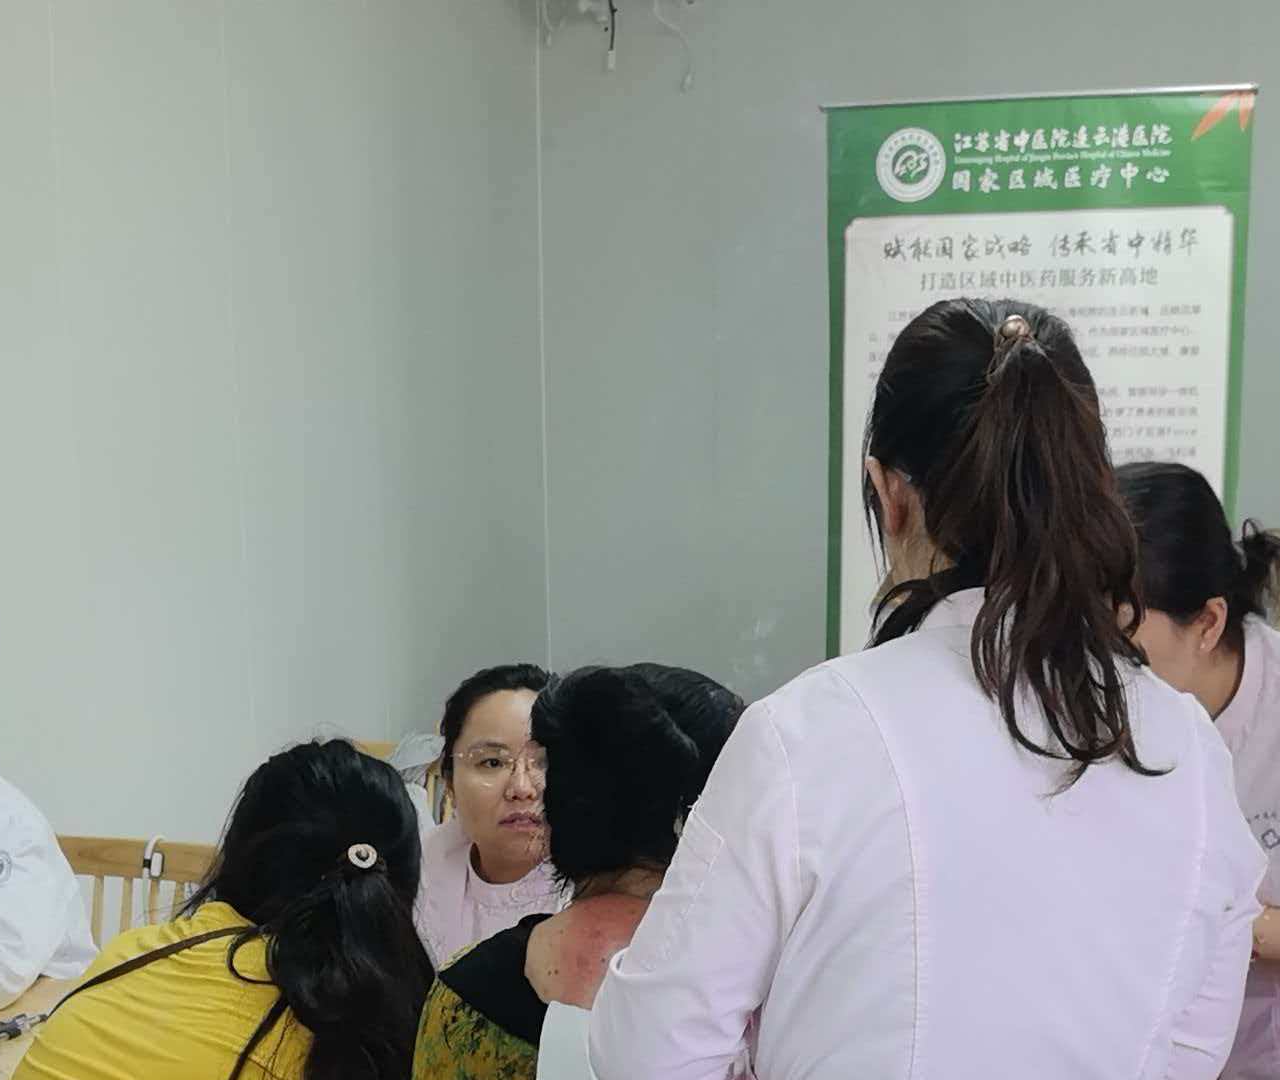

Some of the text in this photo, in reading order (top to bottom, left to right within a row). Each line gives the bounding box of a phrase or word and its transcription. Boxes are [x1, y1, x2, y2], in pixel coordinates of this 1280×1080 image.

[953, 123, 1172, 153] 江苏省中医院连云港医院
[952, 162, 1170, 193] 国家区域医疗中心
[920, 265, 1159, 291] 打造区域中医药服务新高地
